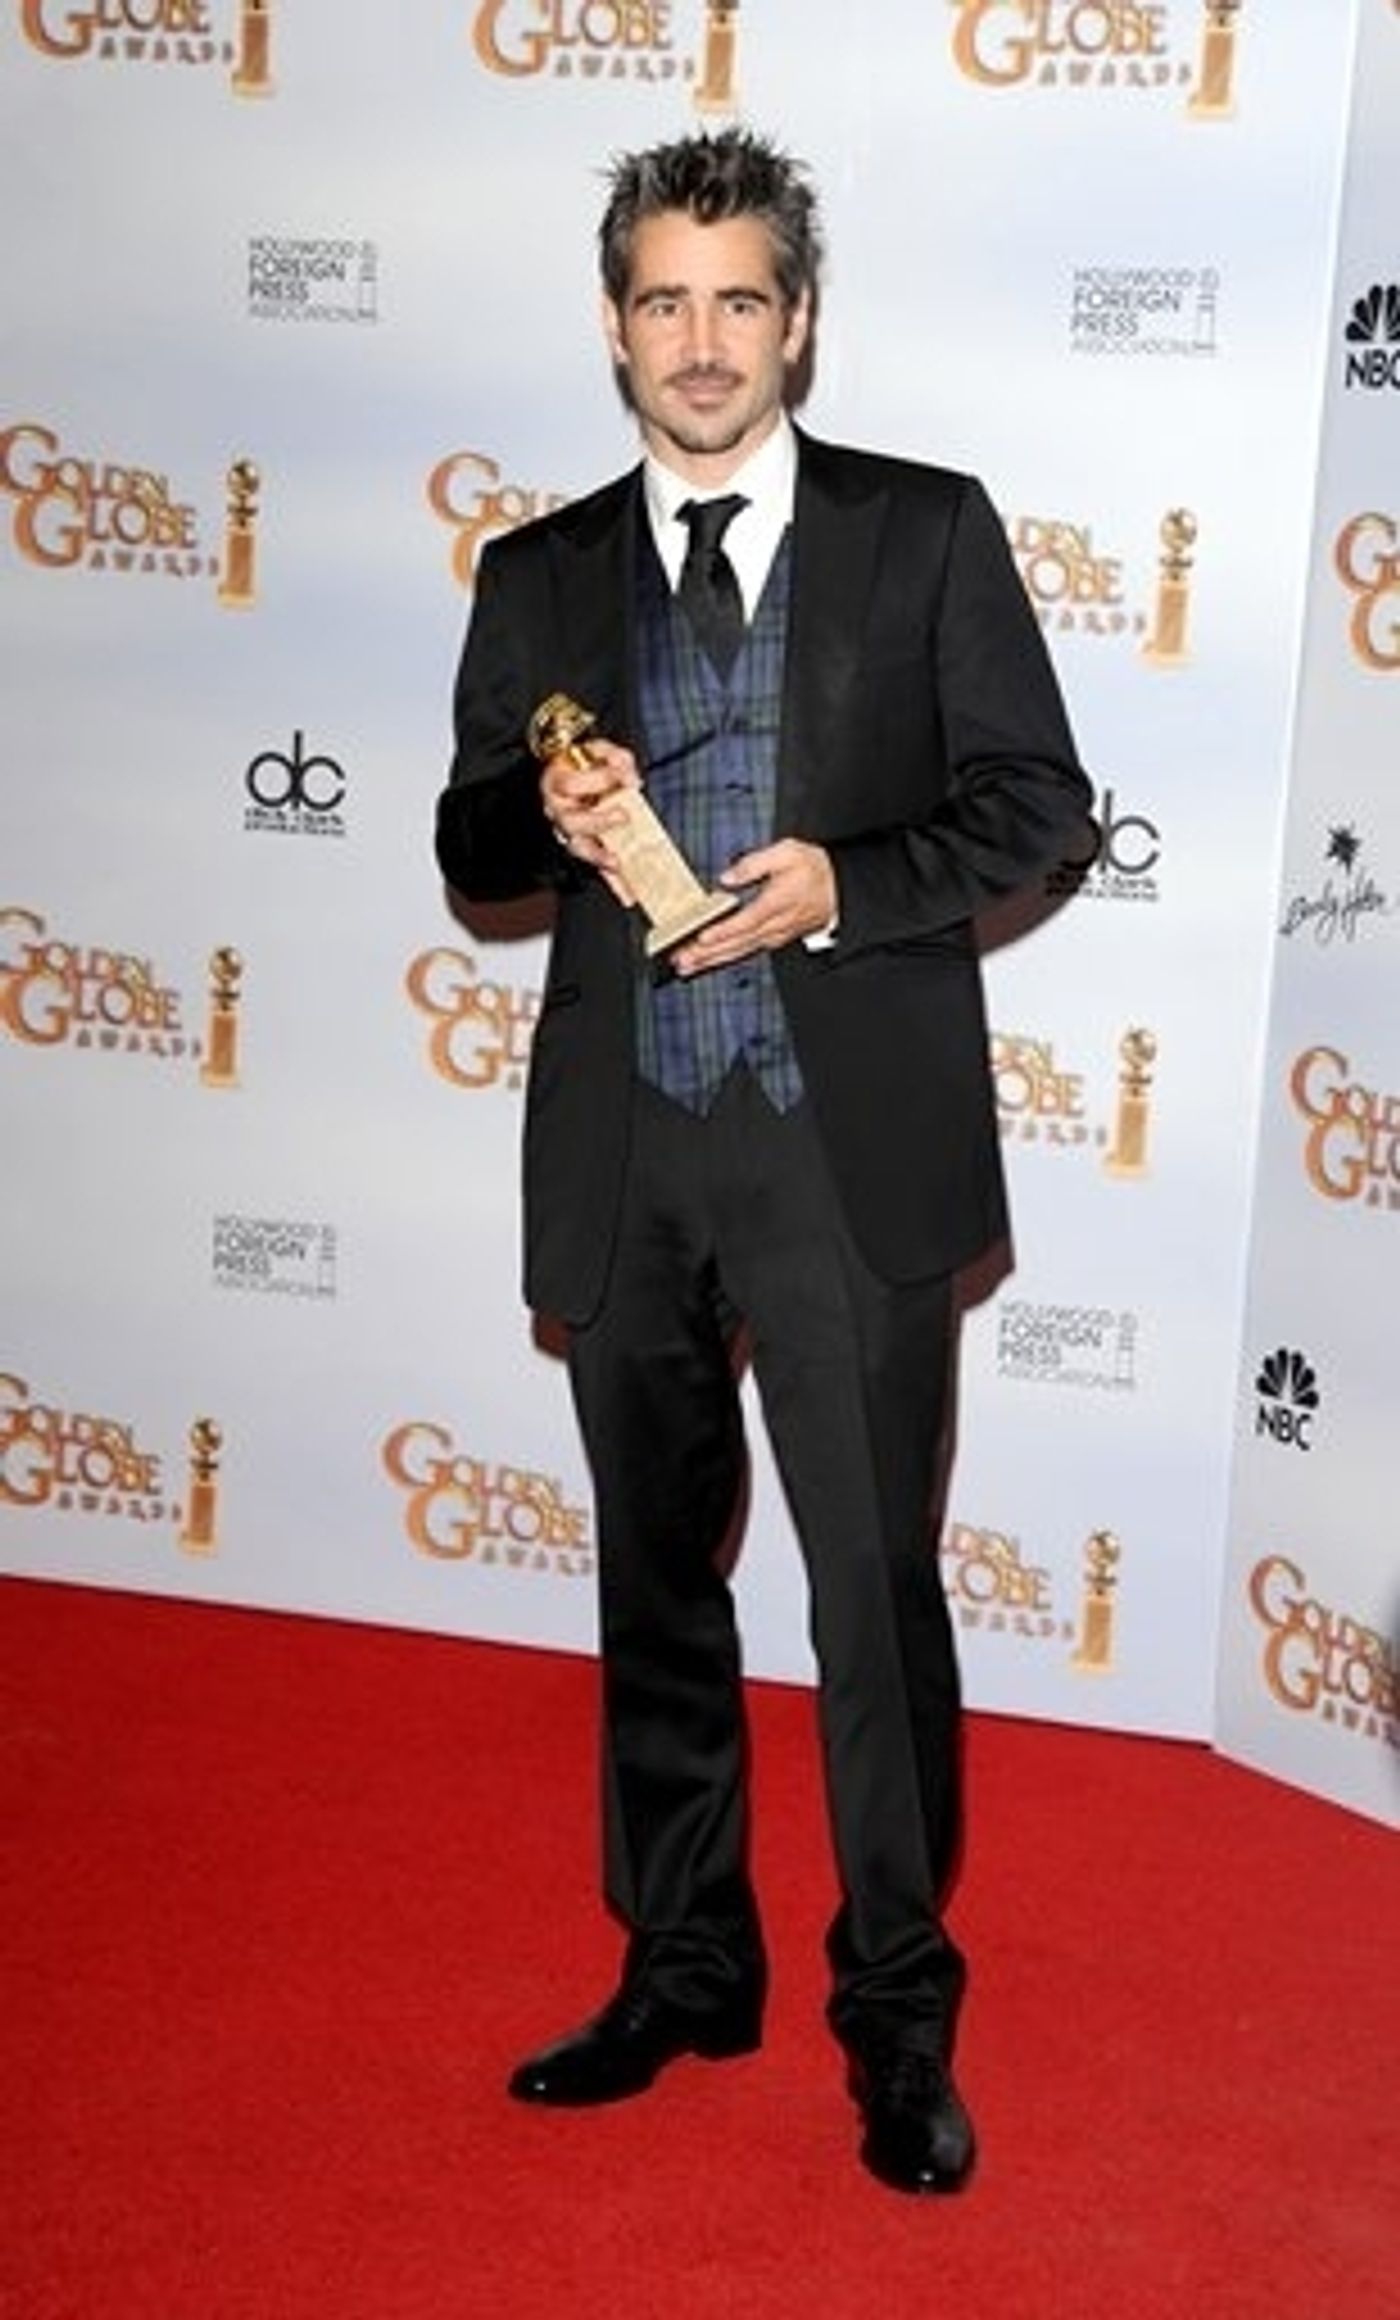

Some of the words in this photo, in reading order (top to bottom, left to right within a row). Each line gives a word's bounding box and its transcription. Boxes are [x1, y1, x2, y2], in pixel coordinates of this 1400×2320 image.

[472, 0, 672, 76] GLOBE
[954, 0, 1167, 87] GLOBE
[1038, 62, 1192, 87] AWARDS
[249, 254, 345, 282] FOREIGN
[249, 280, 309, 304] PRESS
[1070, 312, 1138, 336] PRESS
[1073, 286, 1180, 313] FOREIGN
[0, 424, 169, 505] GOLDEN
[14, 492, 197, 568] GLOBE
[1026, 552, 1124, 605] OBE
[245, 729, 346, 812] dc
[0, 968, 182, 1043] GLOBE
[995, 1065, 1084, 1118] OBE
[213, 1231, 305, 1261] FOREIGN
[213, 1251, 272, 1278] PRESS
[998, 1340, 1061, 1366] PRESS
[1000, 1317, 1103, 1348] FOREIGN
[1255, 1403, 1311, 1452] NBC
[384, 1422, 563, 1512] GOLDEN
[407, 1484, 589, 1559] GLOBE
[952, 1555, 1052, 1612] OBE
[959, 1604, 1075, 1642] WARDS
